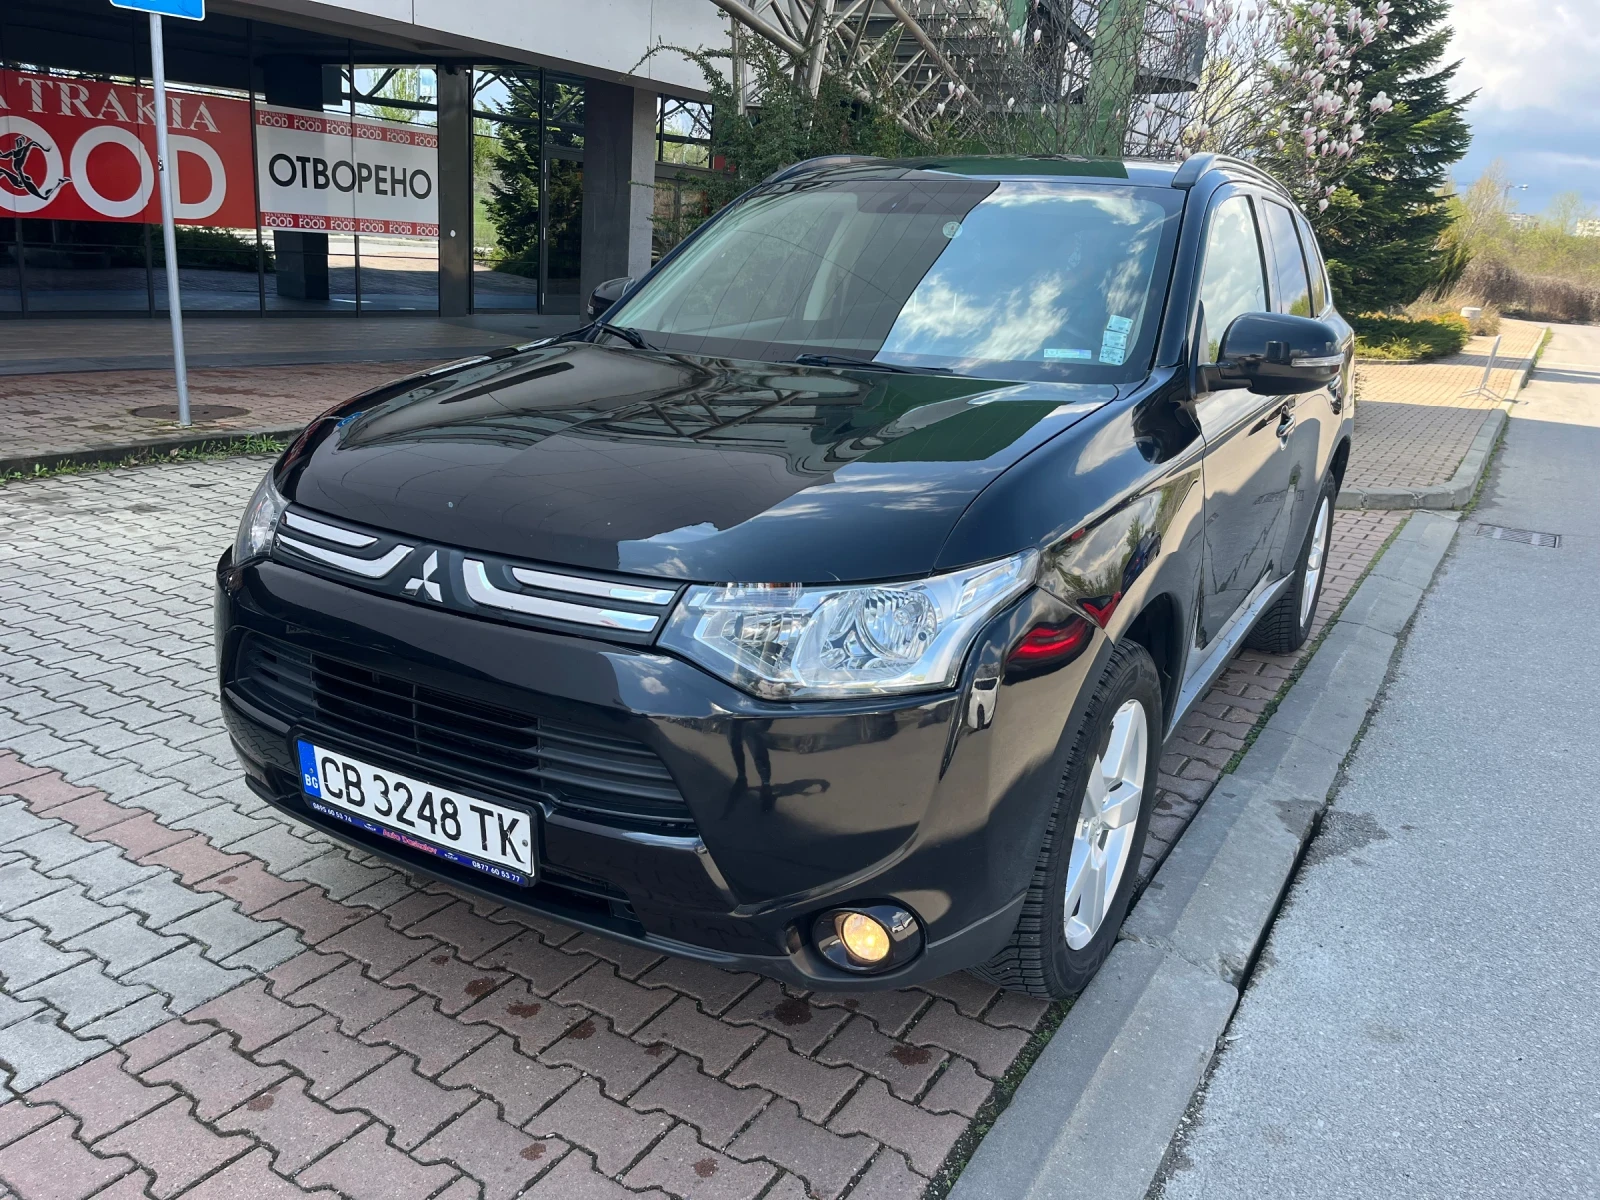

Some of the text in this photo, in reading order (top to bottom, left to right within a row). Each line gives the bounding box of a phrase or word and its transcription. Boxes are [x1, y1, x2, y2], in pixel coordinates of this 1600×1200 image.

[18, 77, 221, 133] TRAKIA
[260, 114, 288, 128] FOOD
[294, 119, 322, 132] FOOD
[326, 123, 352, 136] FOOD
[356, 128, 382, 140] FOOD
[387, 132, 411, 144] FOOD
[414, 136, 438, 148] FOOD
[269, 153, 432, 199] ОТВОРЕНО
[265, 216, 294, 227] FOOD
[299, 218, 326, 229] FOOD
[331, 220, 356, 231] FOOD
[360, 222, 385, 233] FOOD
[389, 225, 412, 235] FOOD
[416, 226, 439, 236] FOOD
[305, 773, 319, 789] BG
[321, 756, 525, 864] CB 3248 TK
[382, 828, 401, 841] Auto
[471, 860, 520, 882] 0877 60 53 77
